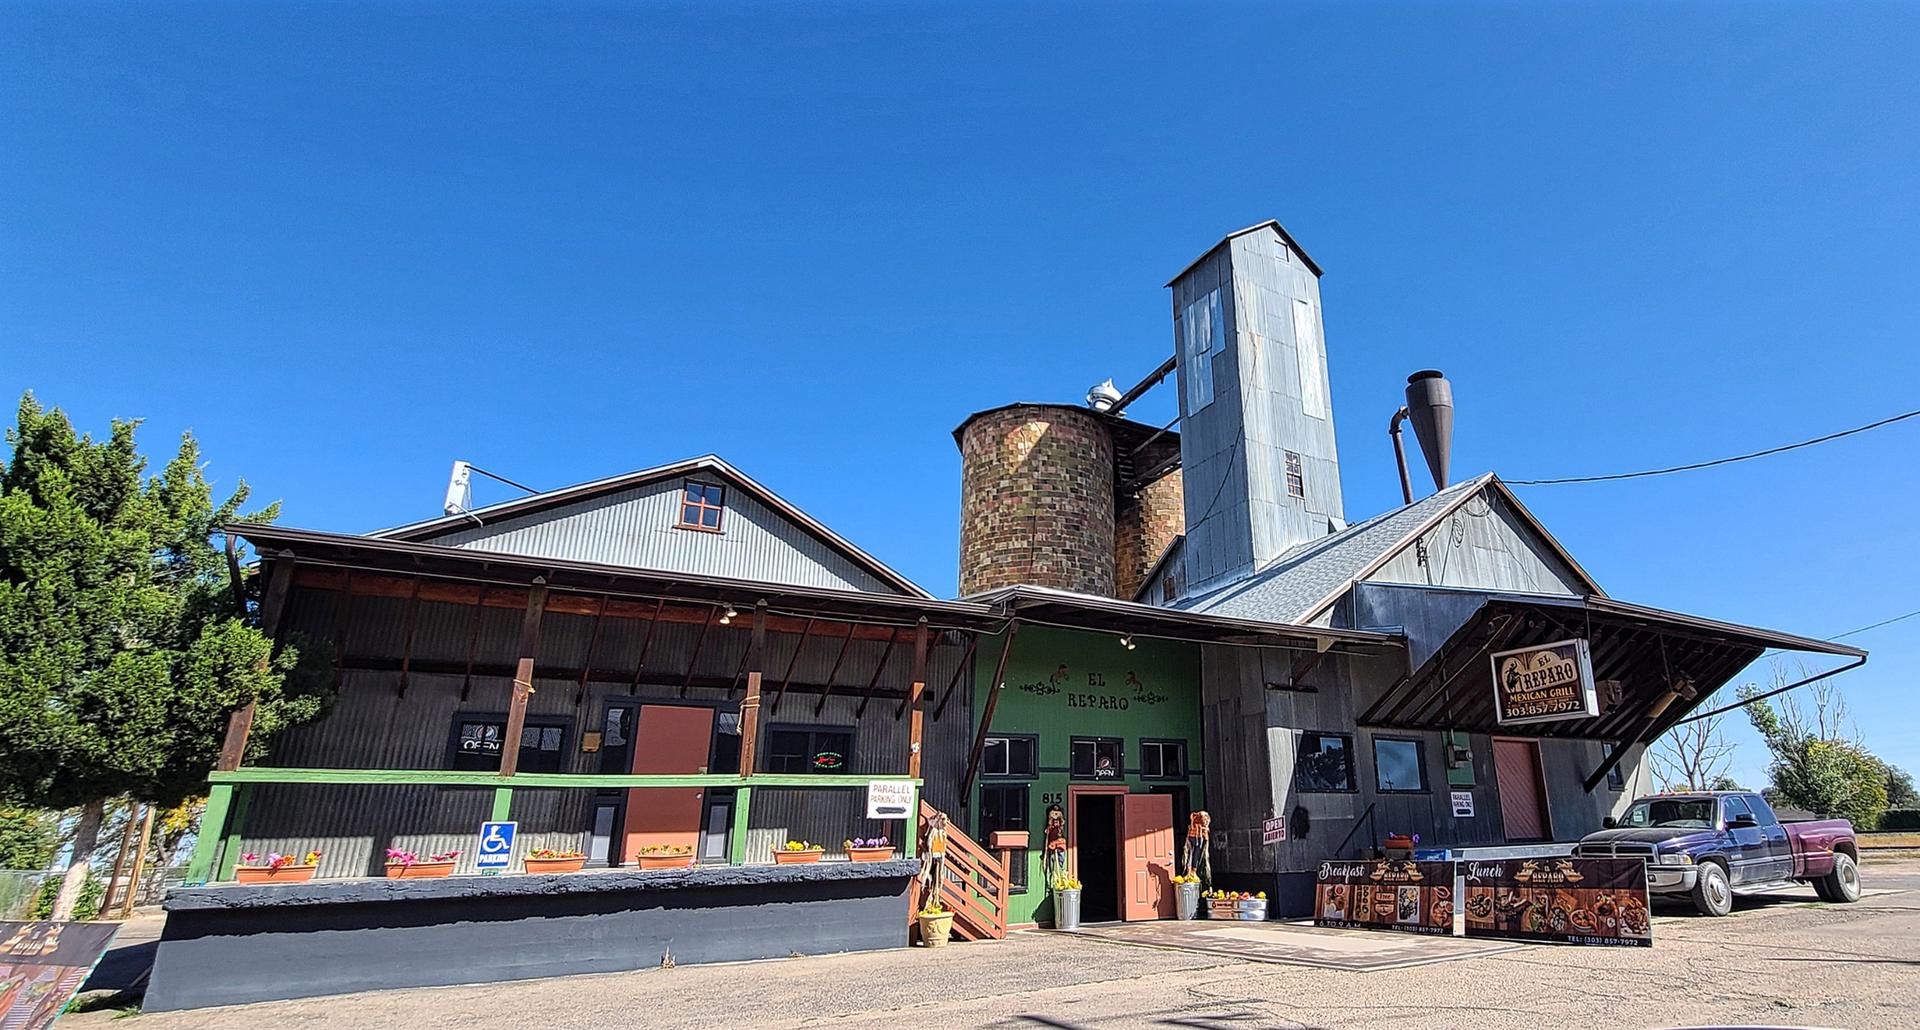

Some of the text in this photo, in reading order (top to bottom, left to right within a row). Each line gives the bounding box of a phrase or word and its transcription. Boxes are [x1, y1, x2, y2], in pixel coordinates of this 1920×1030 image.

[1537, 654, 1551, 667] EL
[1088, 672, 1106, 687] EL
[1523, 662, 1574, 690] REPARO
[1067, 693, 1129, 711] REPARO
[1509, 686, 1575, 703] MEXICAN GRILL
[1505, 700, 1580, 718] 303.857.7972
[873, 784, 911, 794] PARALLEL
[870, 794, 912, 804] PARKING ONLY
[1042, 792, 1063, 804] 815
[1265, 818, 1283, 831] OPEN
[1319, 862, 1366, 884] Breakfast
[1466, 862, 1503, 883] Lunch
[1567, 935, 1638, 946] TEL: (303) 857-7972
